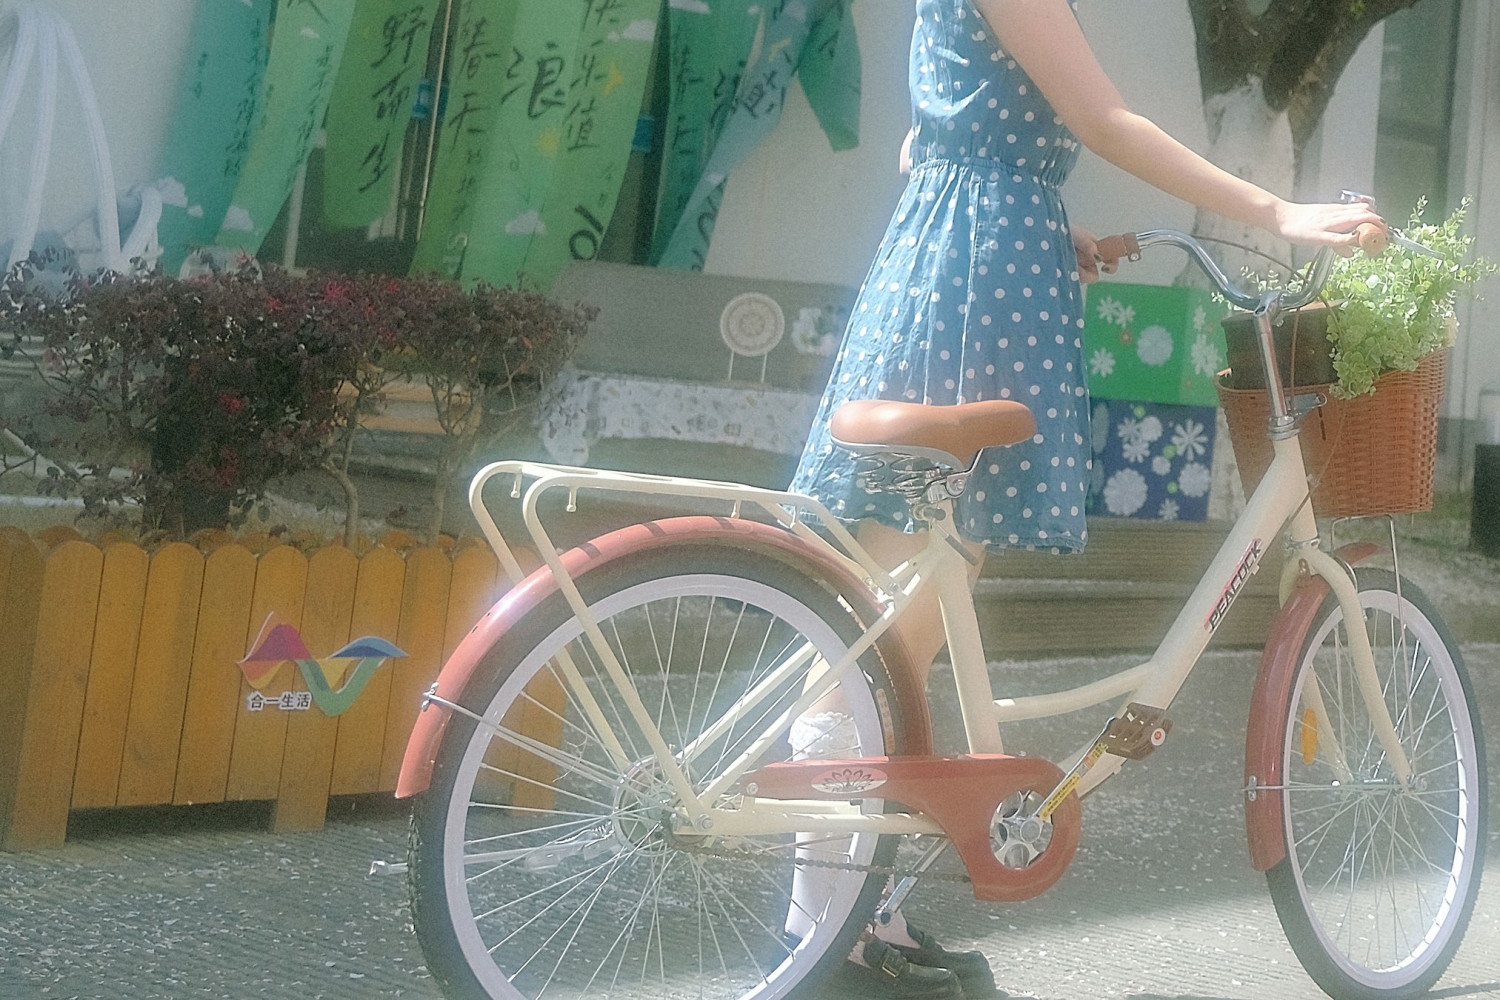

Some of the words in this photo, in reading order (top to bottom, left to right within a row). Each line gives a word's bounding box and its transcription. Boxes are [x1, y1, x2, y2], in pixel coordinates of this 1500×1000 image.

[1208, 539, 1262, 634] PEACOCK
[250, 692, 311, 710] 合一生活
